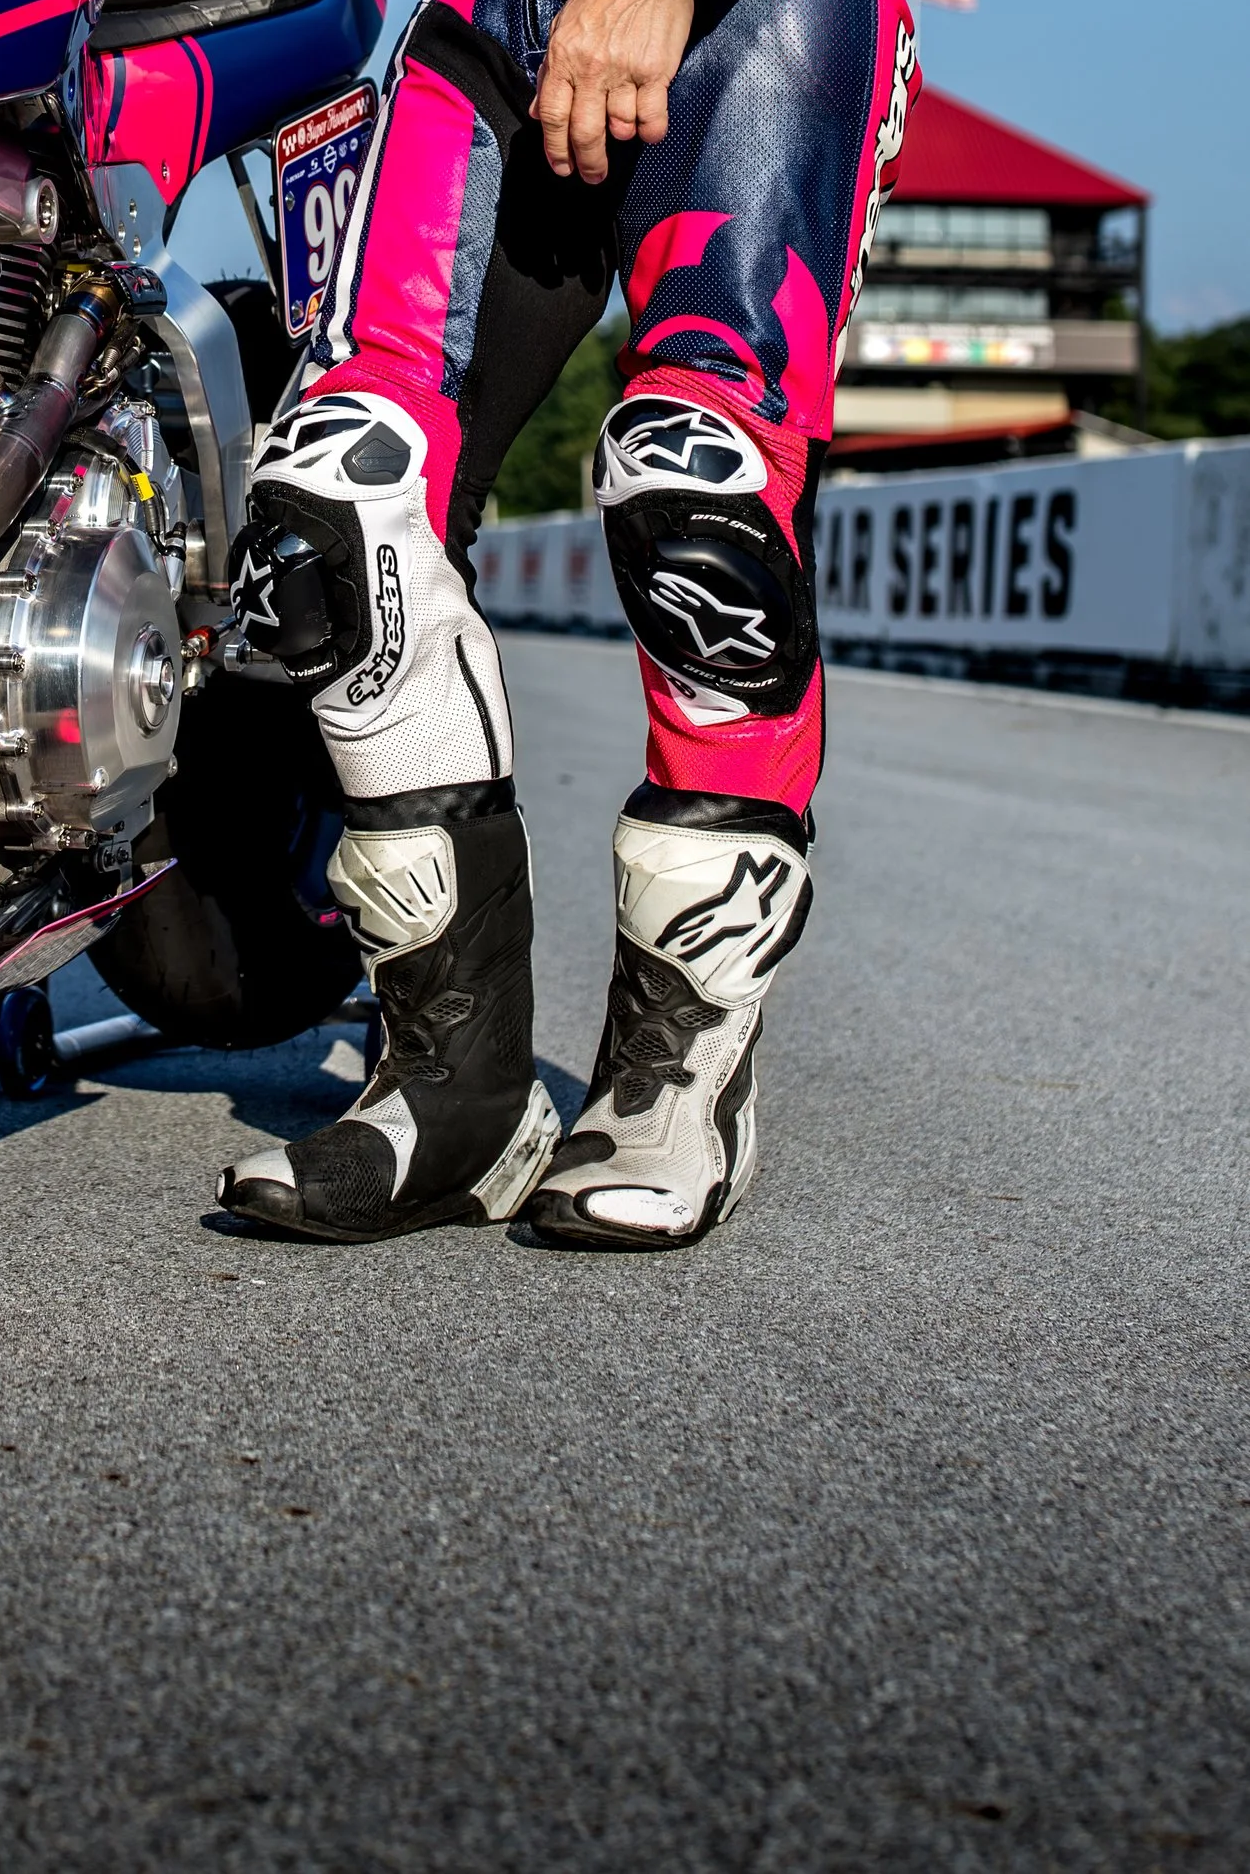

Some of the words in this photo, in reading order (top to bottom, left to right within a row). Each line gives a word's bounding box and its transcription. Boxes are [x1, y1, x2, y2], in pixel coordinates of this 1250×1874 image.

[690, 513, 729, 524] one
[728, 520, 769, 543] goal.
[816, 507, 873, 615] AR
[888, 489, 1077, 618] SERIES
[347, 544, 405, 706] alpinestars
[682, 663, 717, 680] one
[719, 676, 778, 689] vision.
